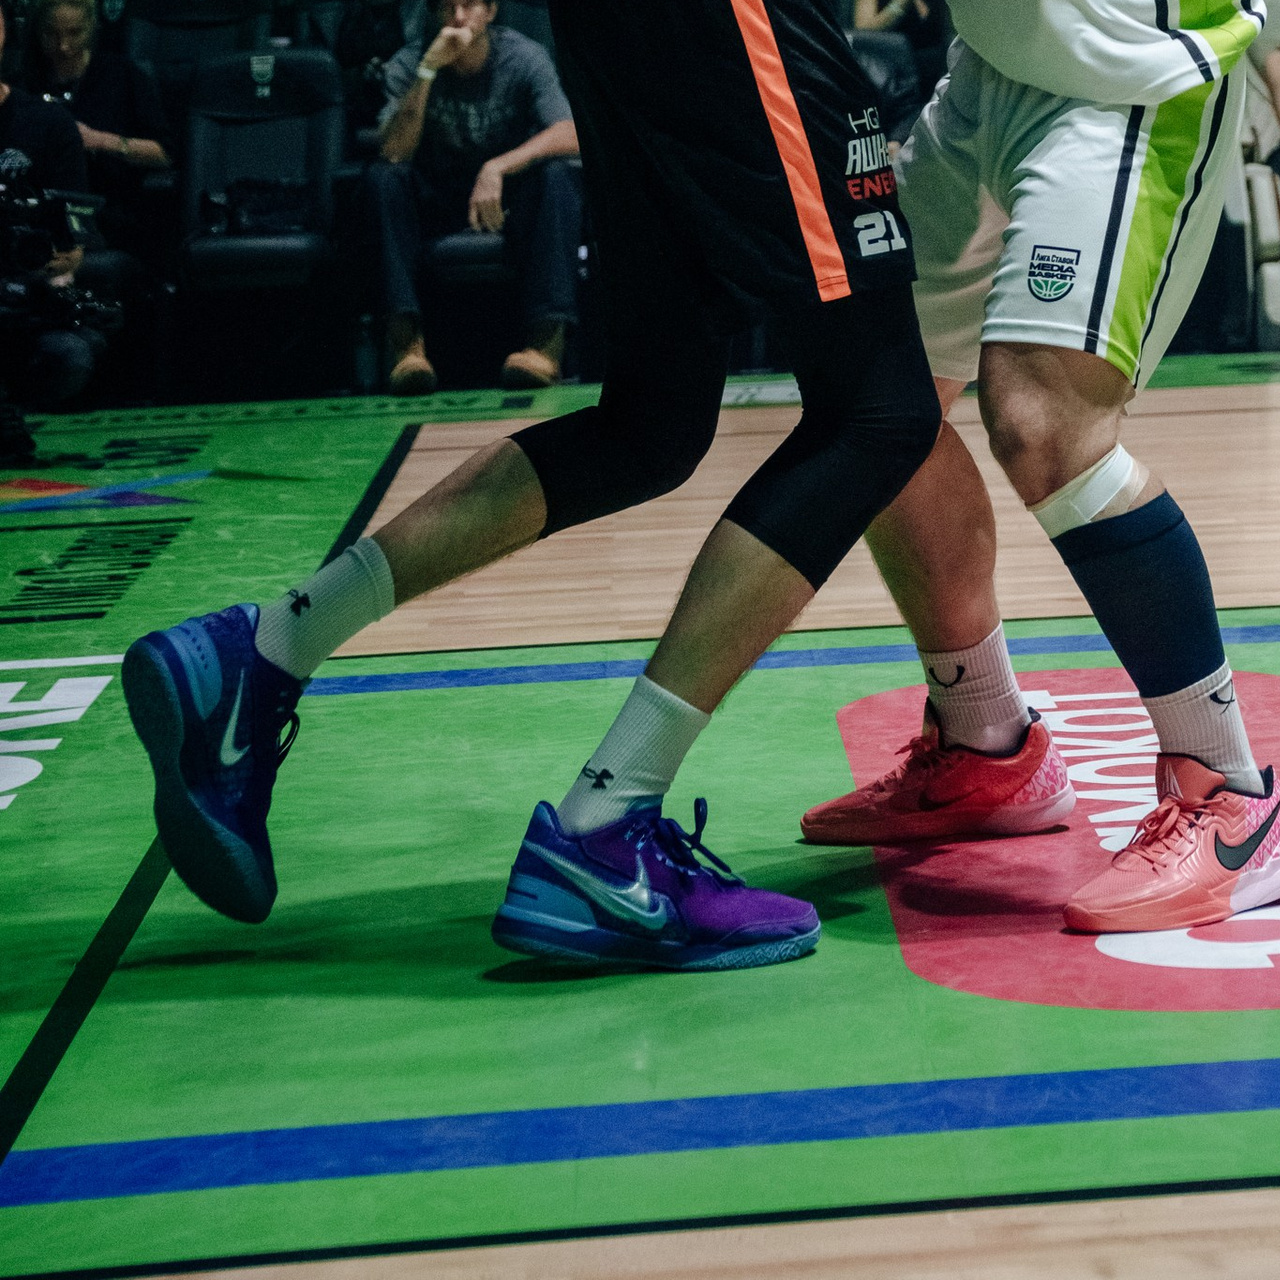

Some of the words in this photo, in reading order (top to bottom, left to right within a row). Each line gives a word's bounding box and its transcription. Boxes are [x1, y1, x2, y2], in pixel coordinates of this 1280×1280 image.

[853, 210, 907, 257] 21
[1029, 262, 1077, 275] MEDIA
[1028, 270, 1077, 282] BASKET
